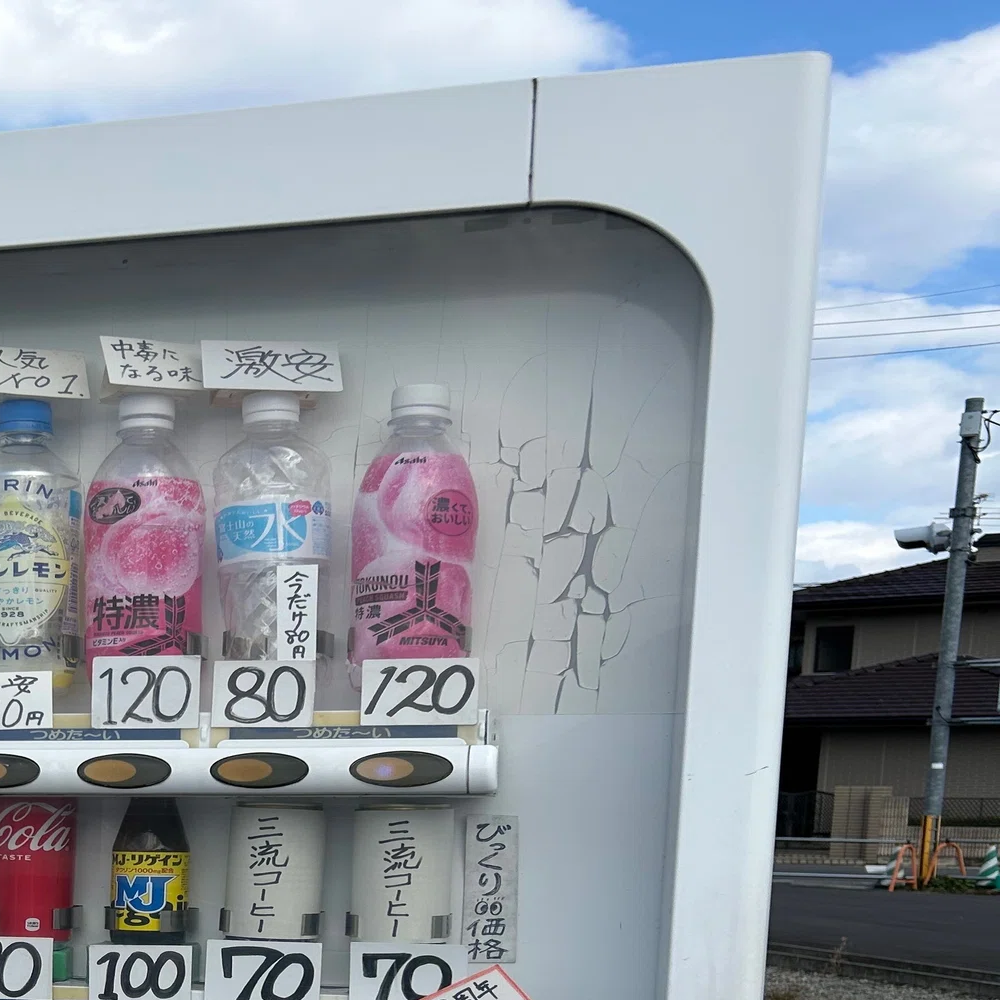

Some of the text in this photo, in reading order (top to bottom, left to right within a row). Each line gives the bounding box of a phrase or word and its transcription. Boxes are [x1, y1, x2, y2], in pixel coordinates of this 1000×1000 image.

[110, 339, 180, 362] 中毒に
[220, 345, 335, 385] 激安
[119, 364, 203, 383] なる味
[394, 456, 427, 465] Asahi
[3, 510, 44, 526] BEVERAGE
[248, 495, 306, 552] 水
[431, 513, 471, 526] おいしい
[93, 594, 159, 631] 特濃
[354, 604, 381, 620] 特濃
[399, 635, 448, 646] MITSUYA
[99, 665, 193, 726] 120
[223, 665, 307, 724] 80
[364, 664, 476, 718] 120
[115, 874, 179, 914] MJ
[247, 816, 291, 934] 三流コーヒー
[378, 820, 424, 938] 三流コーヒー
[95, 950, 187, 1000] 100
